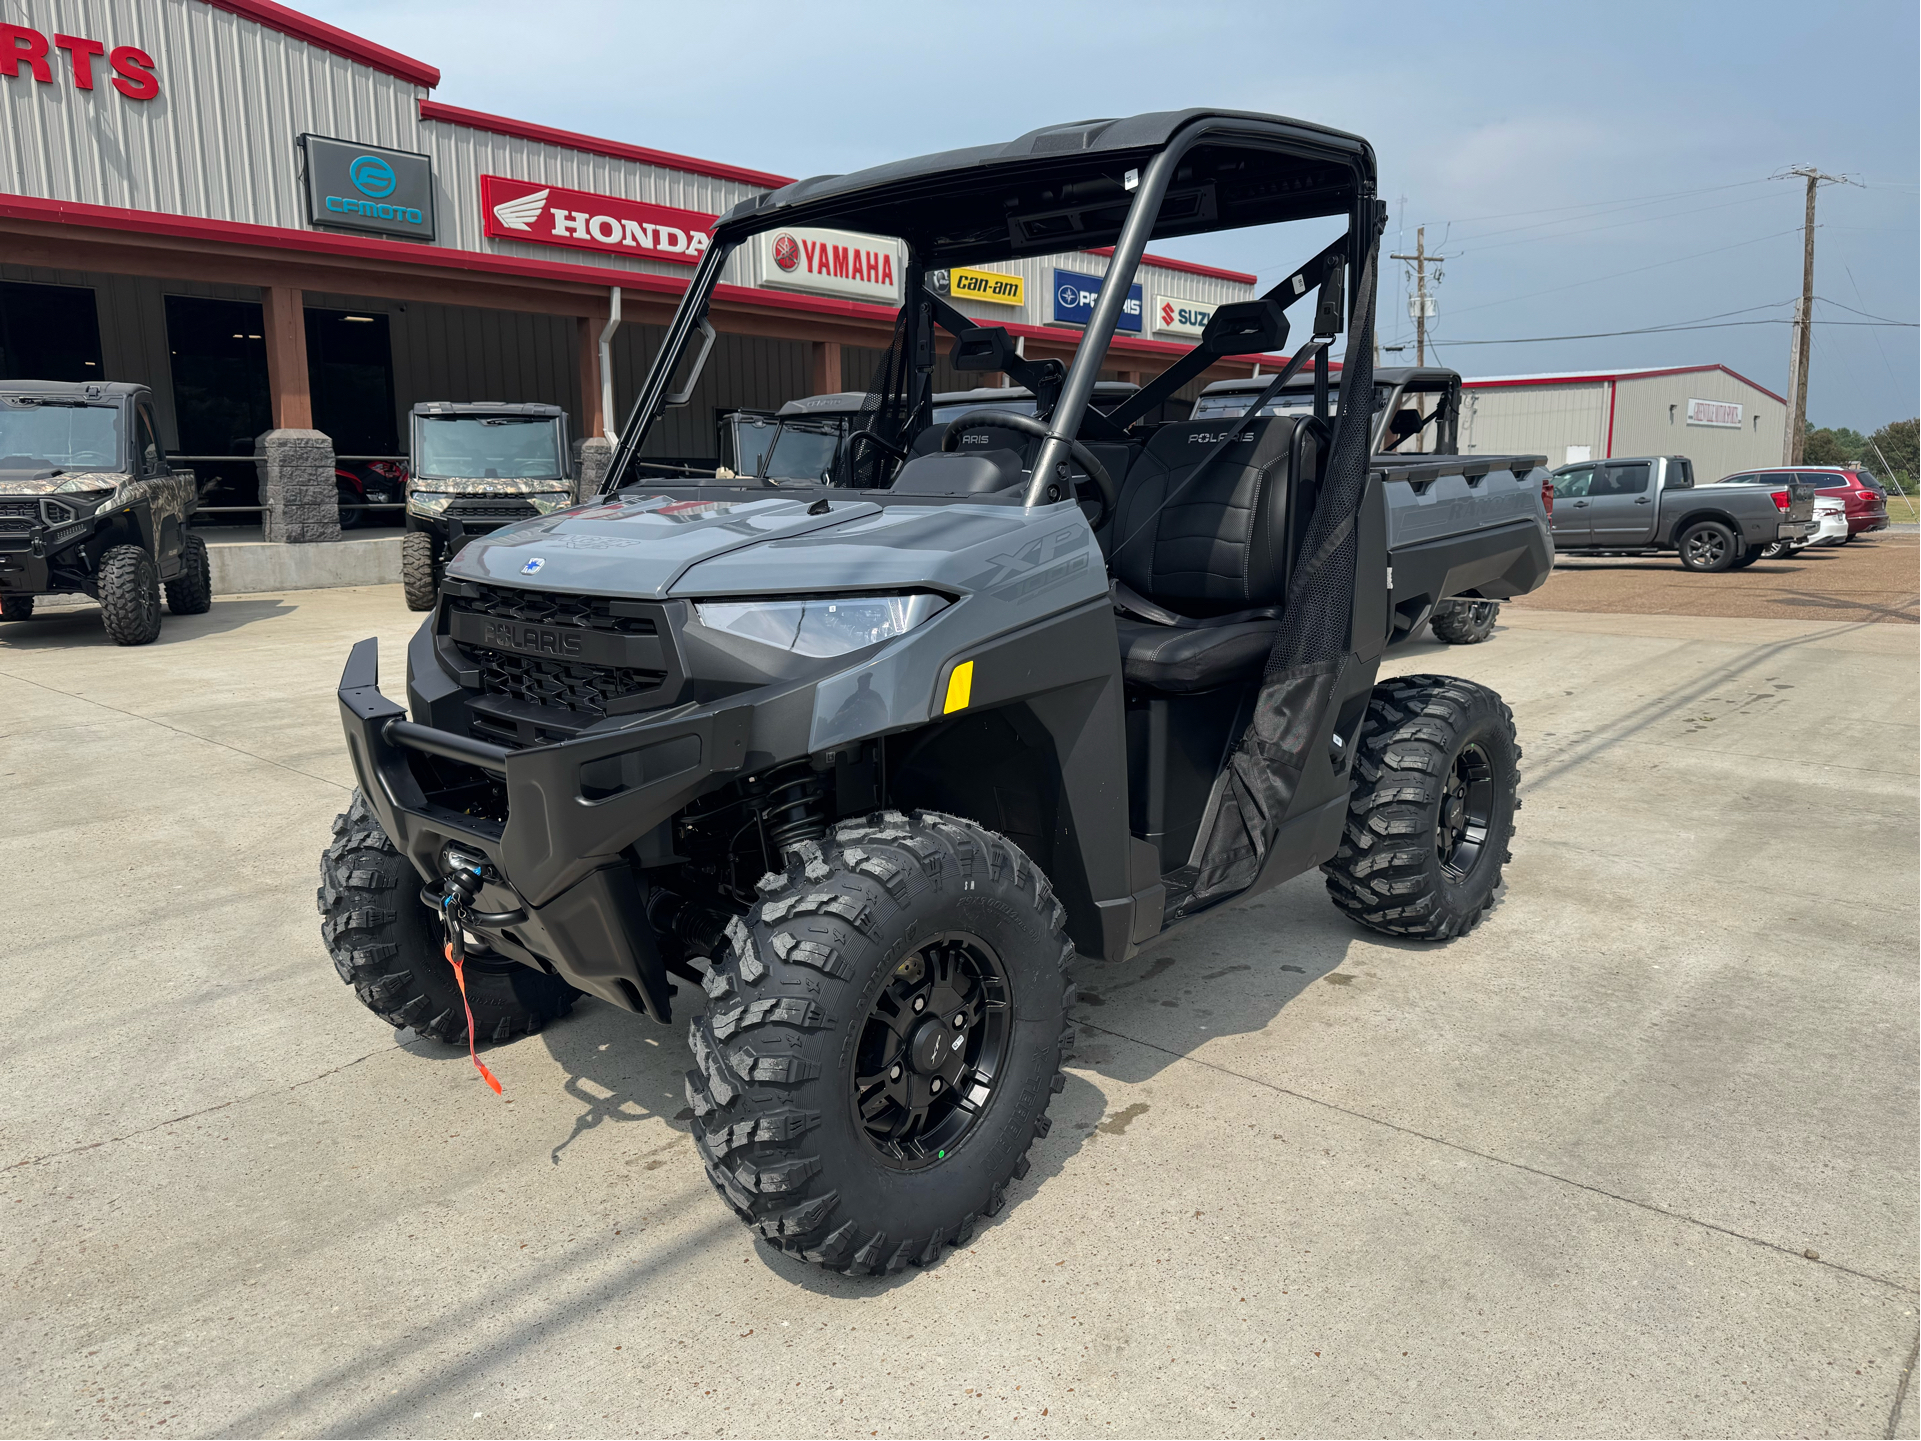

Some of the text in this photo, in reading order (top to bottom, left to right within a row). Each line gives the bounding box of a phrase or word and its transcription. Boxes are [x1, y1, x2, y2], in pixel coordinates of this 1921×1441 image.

[0, 22, 160, 100] RTS
[325, 195, 423, 224] CFMOTO
[549, 207, 710, 257] HONDA
[801, 238, 894, 286] YAMAHA
[956, 275, 1018, 297] can-am
[982, 522, 1085, 592] XP
[484, 620, 583, 658] POLARIS
[855, 937, 903, 1014] ARMOR
